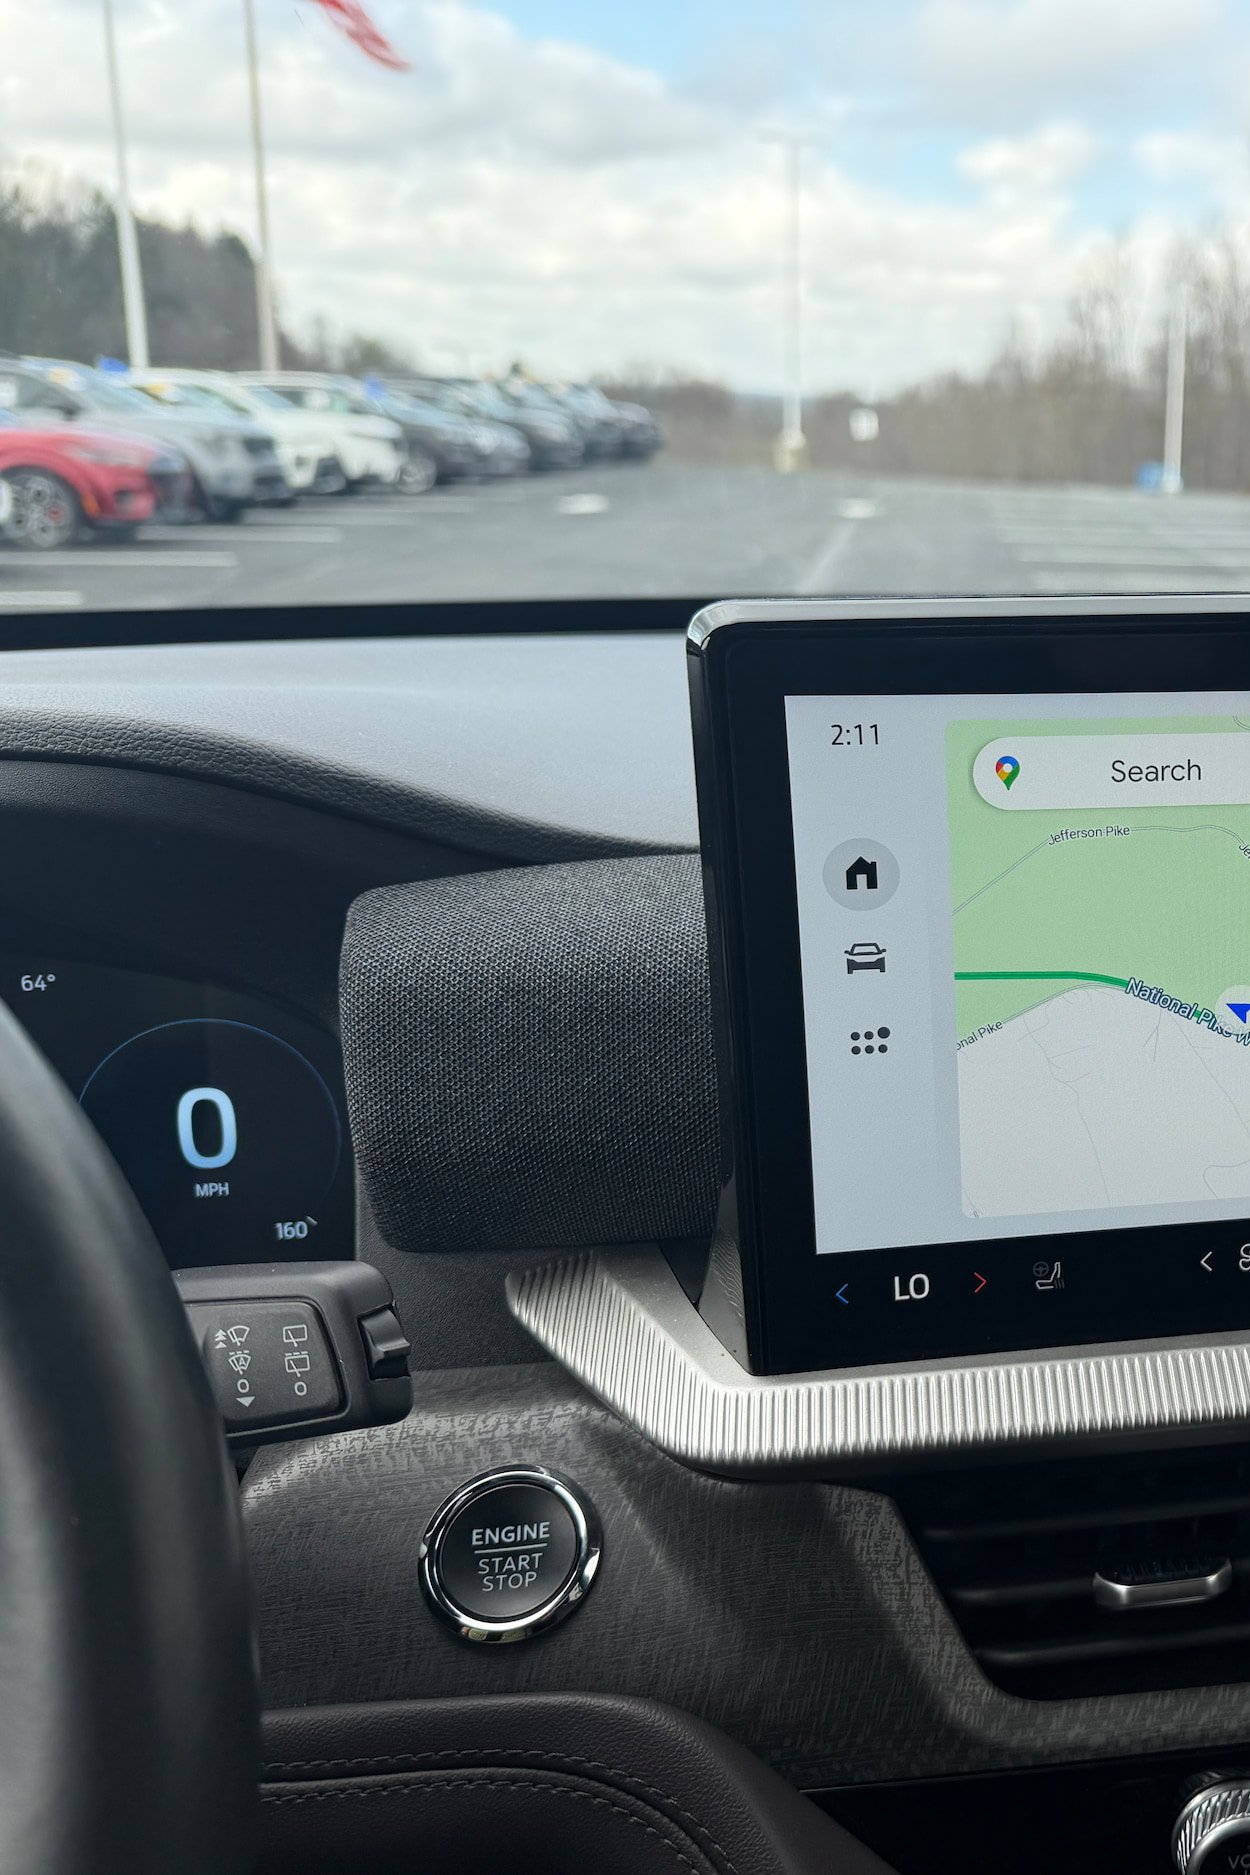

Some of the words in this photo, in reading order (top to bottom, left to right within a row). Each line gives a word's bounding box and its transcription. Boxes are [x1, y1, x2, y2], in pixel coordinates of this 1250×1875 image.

[831, 723, 880, 748] 2:11
[1111, 757, 1203, 785] Search
[1048, 827, 1103, 846] Jefferson
[1106, 825, 1131, 837] Pike
[1125, 977, 1197, 1020] National
[976, 1020, 1003, 1038] Pike
[177, 1087, 237, 1169] 0
[194, 1182, 230, 1198] MPH
[274, 1221, 308, 1240] 160
[894, 1273, 930, 1301] LO
[471, 1521, 551, 1545] ENGINE
[477, 1552, 543, 1575] START
[481, 1570, 538, 1592] STOP
